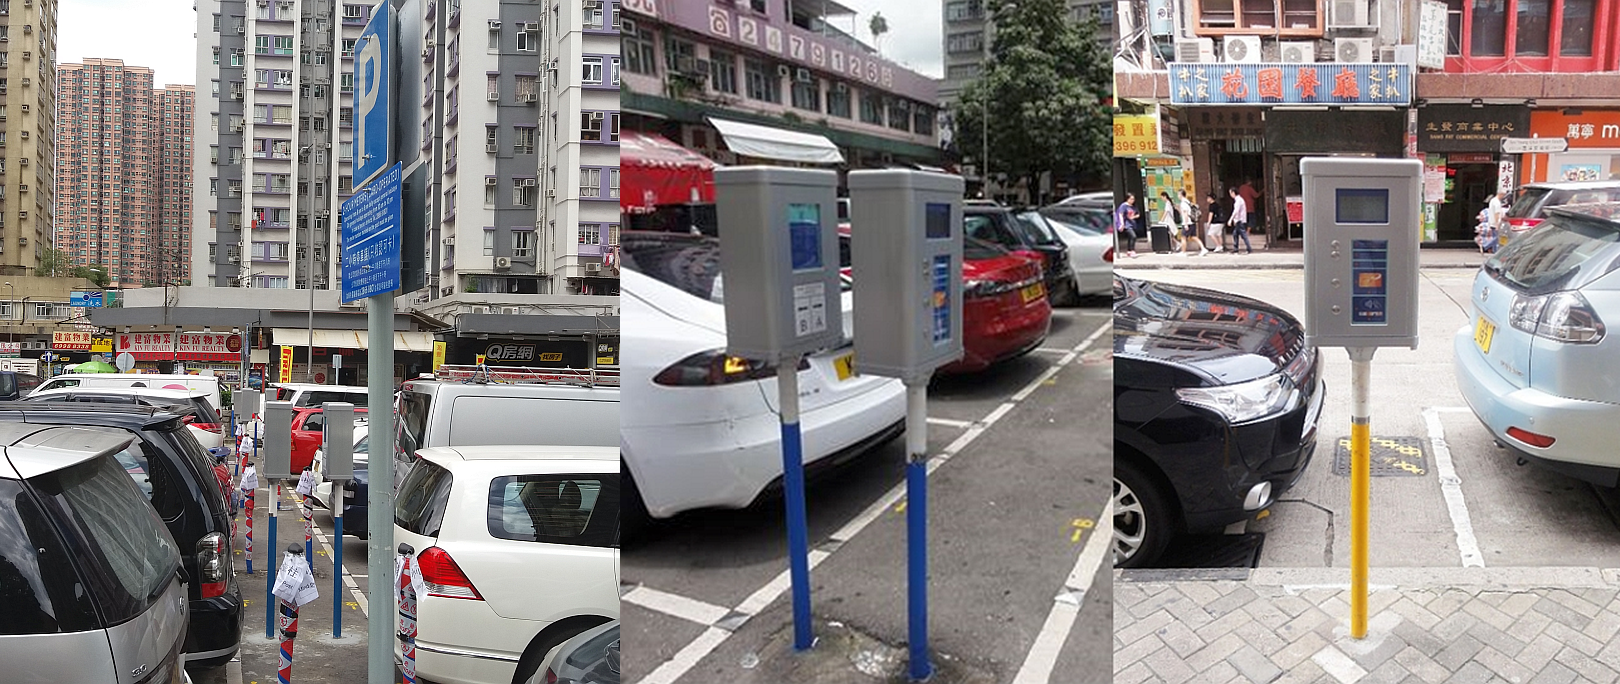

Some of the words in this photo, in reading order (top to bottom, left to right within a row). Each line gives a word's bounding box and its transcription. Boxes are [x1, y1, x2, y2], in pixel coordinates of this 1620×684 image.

[1220, 66, 1360, 99] 花園餐廳
[358, 33, 381, 170] P
[1566, 123, 1595, 140] 萬寧
[1113, 141, 1137, 151] 396
[486, 344, 534, 360] Q房網
